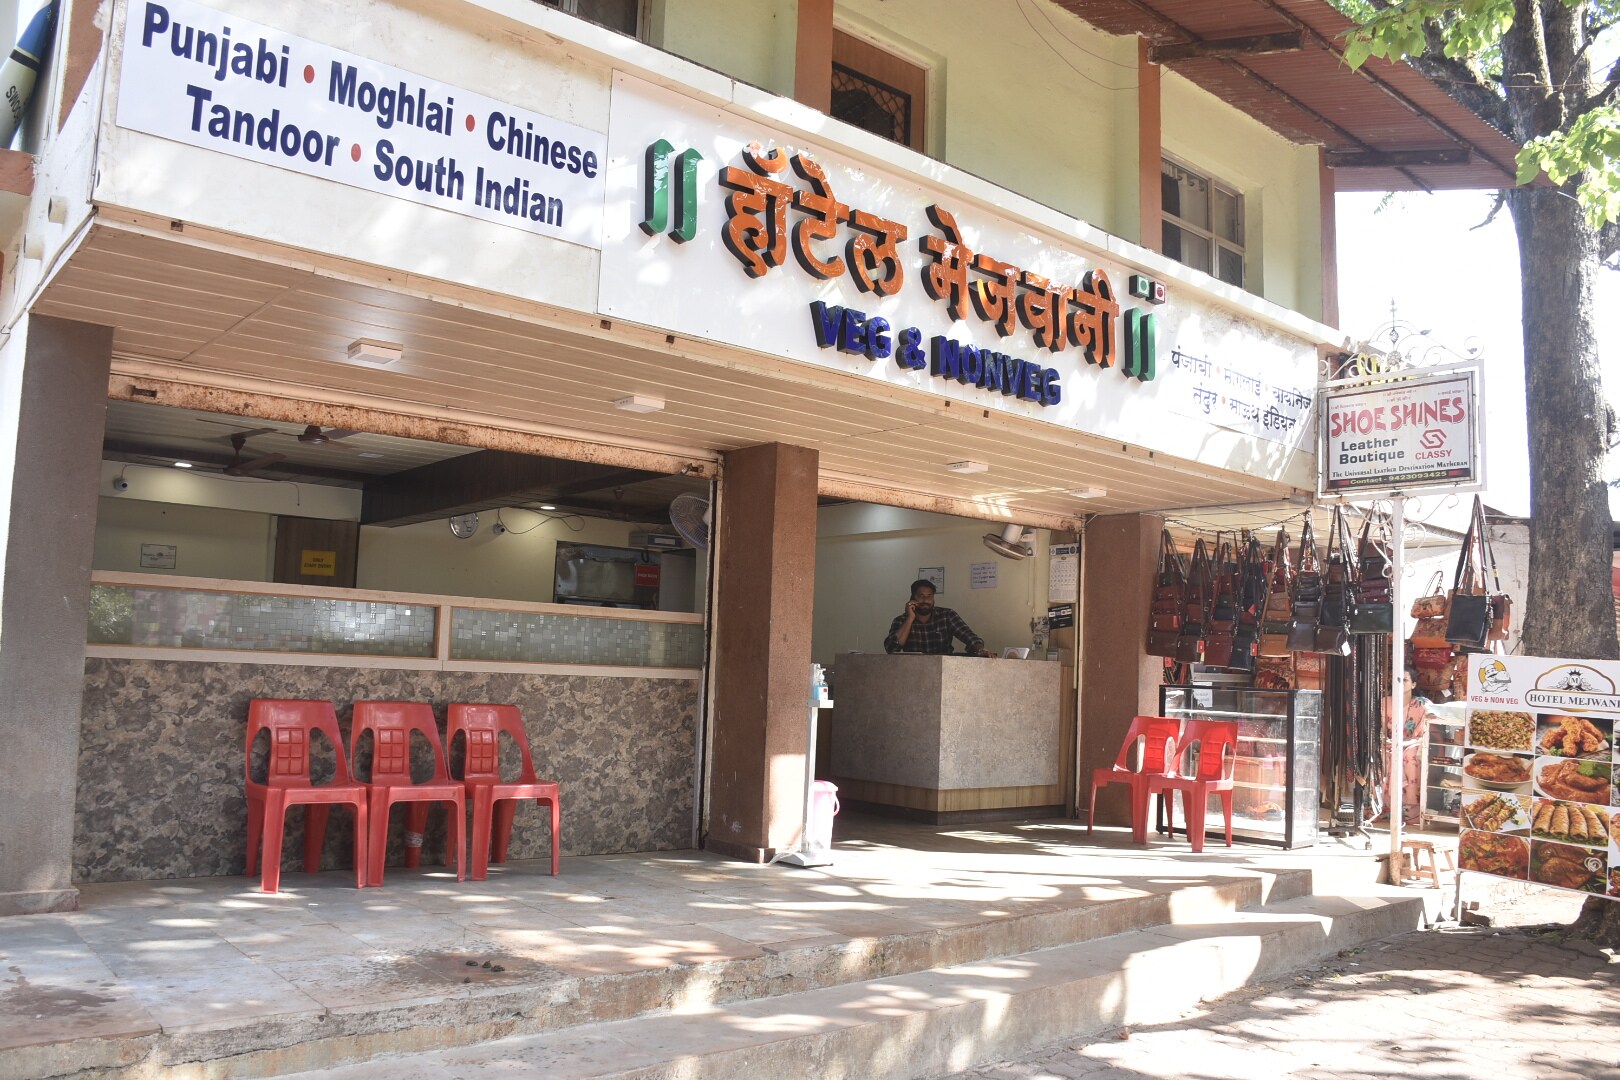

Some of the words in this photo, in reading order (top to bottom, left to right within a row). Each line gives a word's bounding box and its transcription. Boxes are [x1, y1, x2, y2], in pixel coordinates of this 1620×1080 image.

[142, 2, 290, 88] Punjabi
[328, 61, 454, 136] Moghlai
[486, 111, 598, 179] Chinese
[186, 85, 341, 167] Tandoor
[374, 139, 465, 200] South
[475, 166, 564, 228] Indian
[718, 143, 908, 297] हॉटेल
[918, 204, 1121, 370] मेजवानी
[810, 300, 892, 362] VEG
[895, 325, 928, 371] &
[930, 334, 1062, 407] NONVEG
[1331, 407, 1387, 439] SHOE
[1390, 398, 1466, 431] SHINES
[1340, 450, 1405, 465] Boutique
[1341, 438, 1398, 452] Leather
[1415, 449, 1453, 461] CLASSY
[1471, 695, 1483, 703] VEG
[1530, 693, 1566, 705] HOTEL
